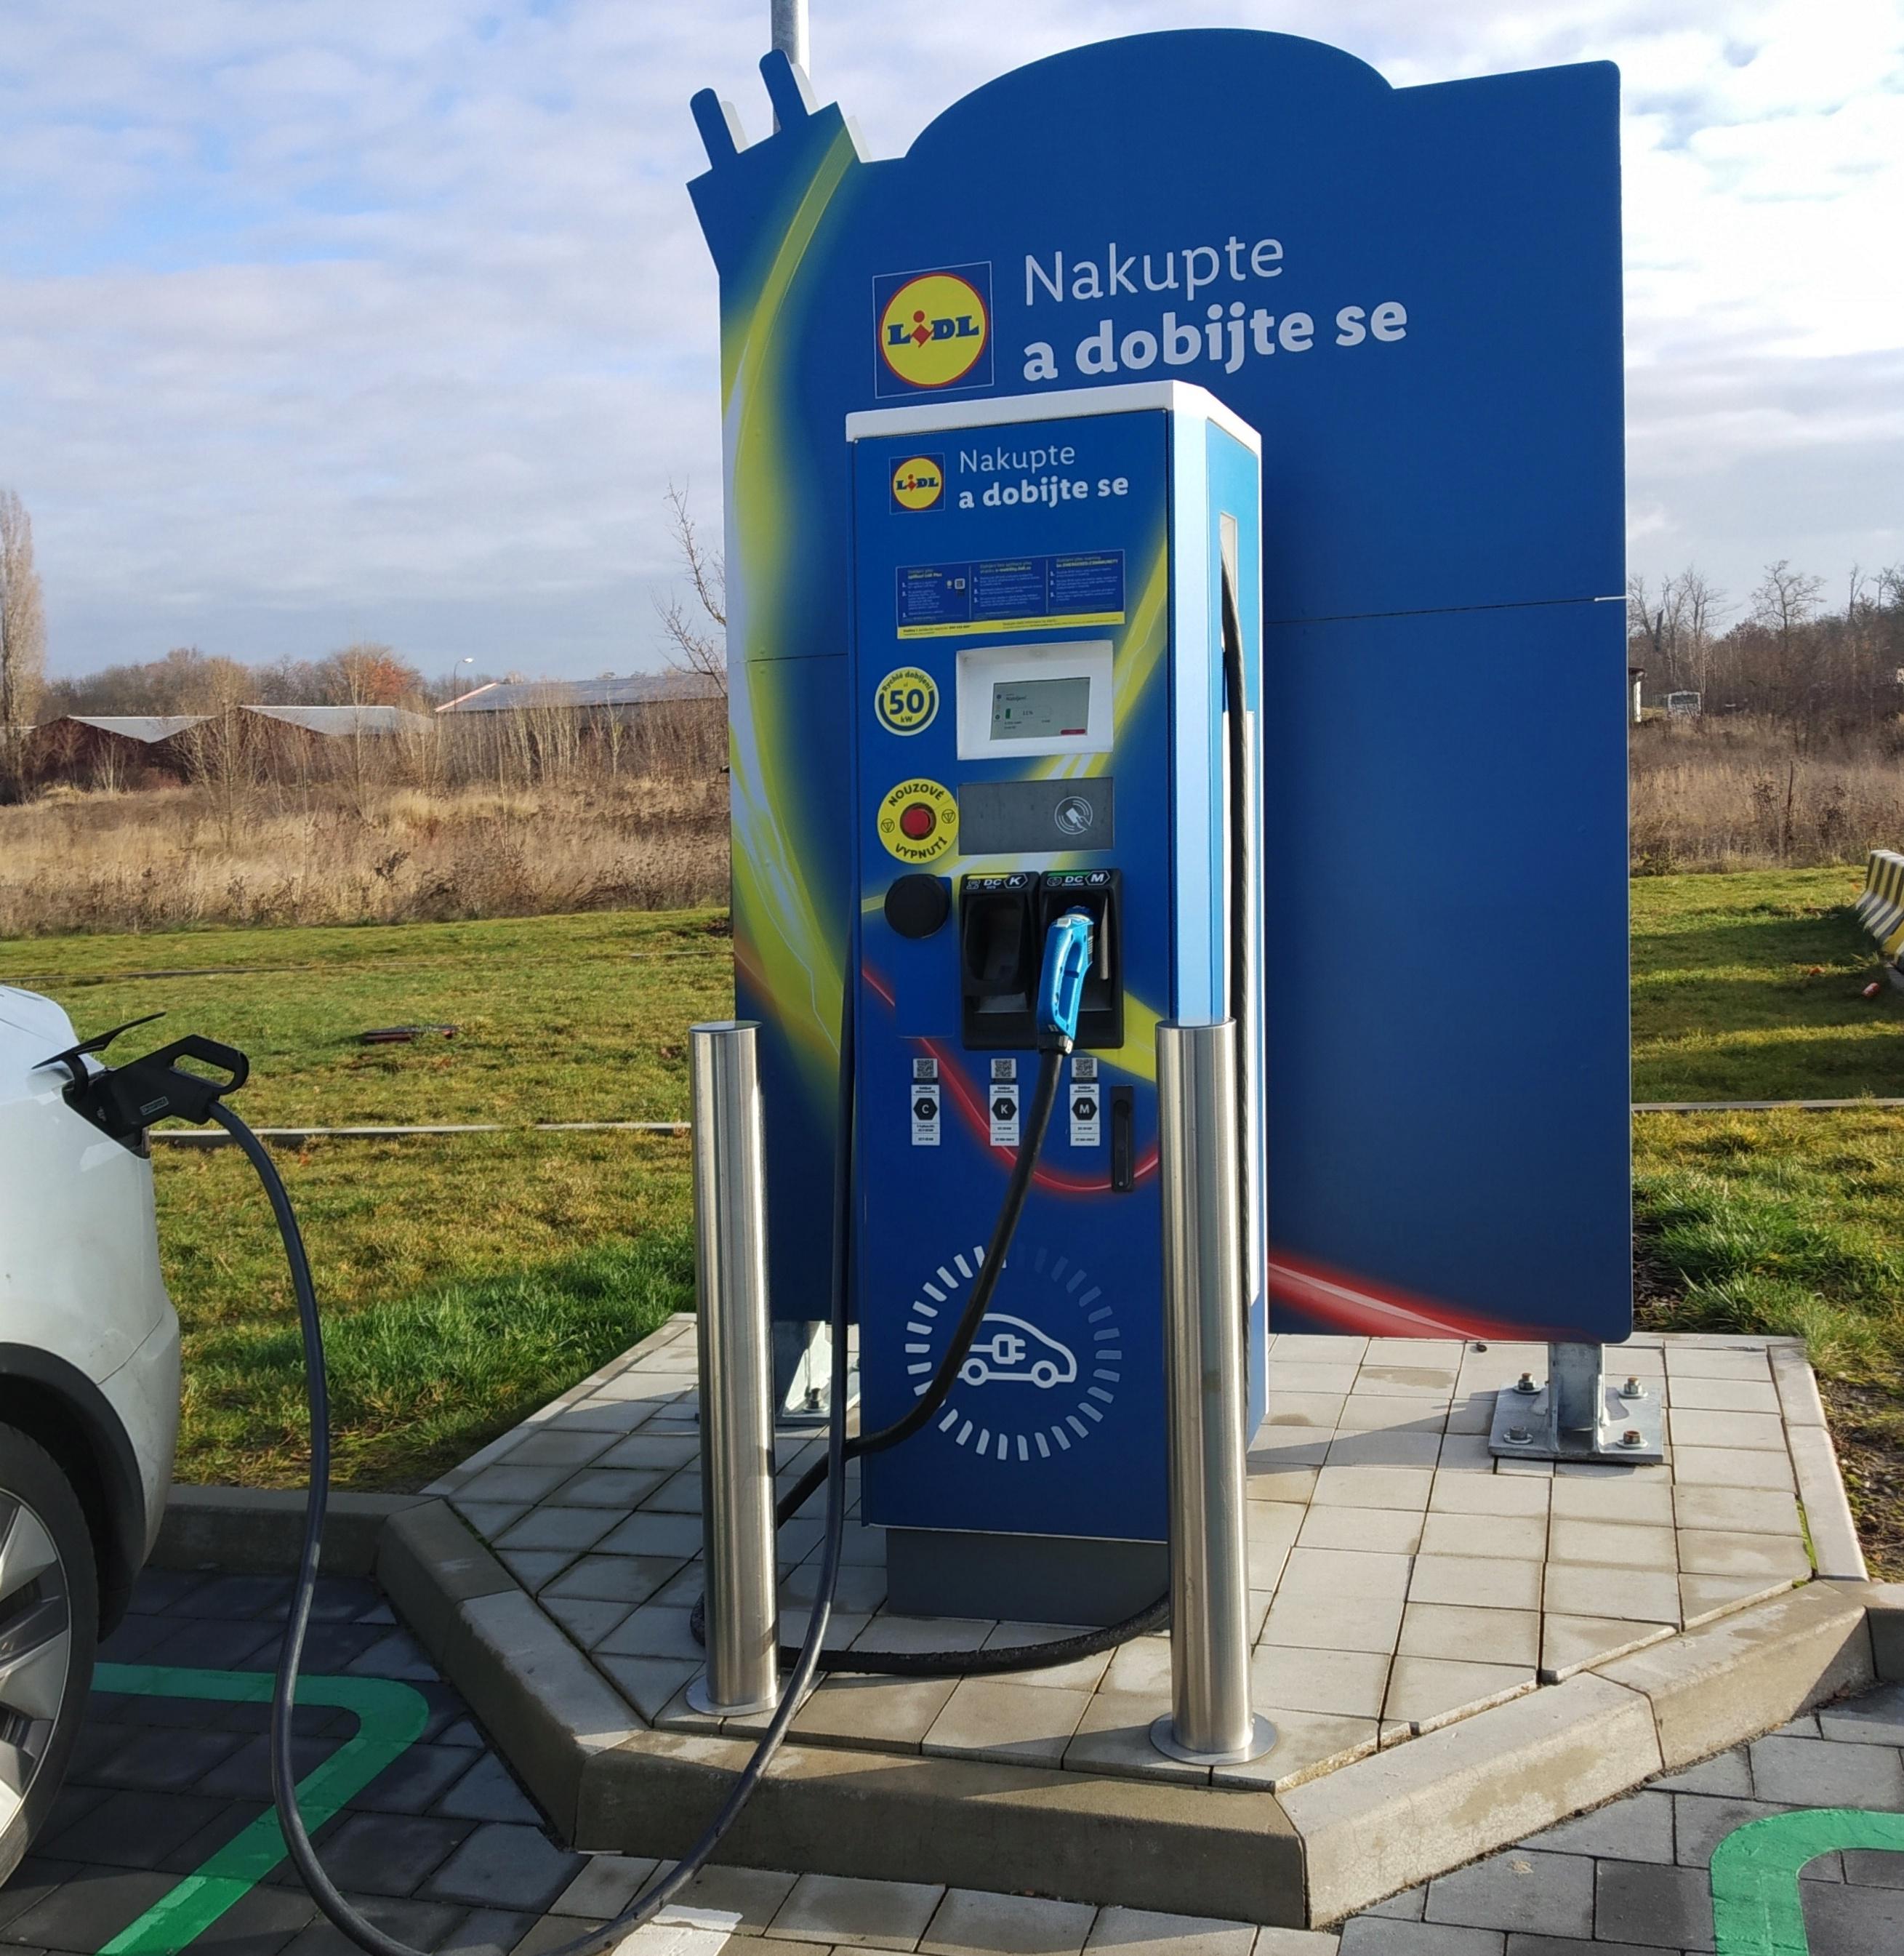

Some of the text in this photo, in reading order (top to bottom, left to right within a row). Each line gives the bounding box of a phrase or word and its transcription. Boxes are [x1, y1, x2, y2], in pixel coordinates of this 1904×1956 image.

[1025, 236, 1284, 306] Nakupte
[1023, 301, 1408, 382] a dobijte se
[959, 445, 1076, 474] Nakupte
[958, 476, 1129, 509] a dobijte se
[889, 688, 925, 716] 50
[900, 715, 913, 724] kW
[888, 782, 945, 807] NOUZOVÉ
[895, 835, 948, 859] VYPNUTÍ
[1009, 876, 1021, 886] K
[1090, 873, 1105, 883] M
[921, 1104, 930, 1114] C
[1000, 1104, 1008, 1114] K
[1079, 1103, 1090, 1114] M
